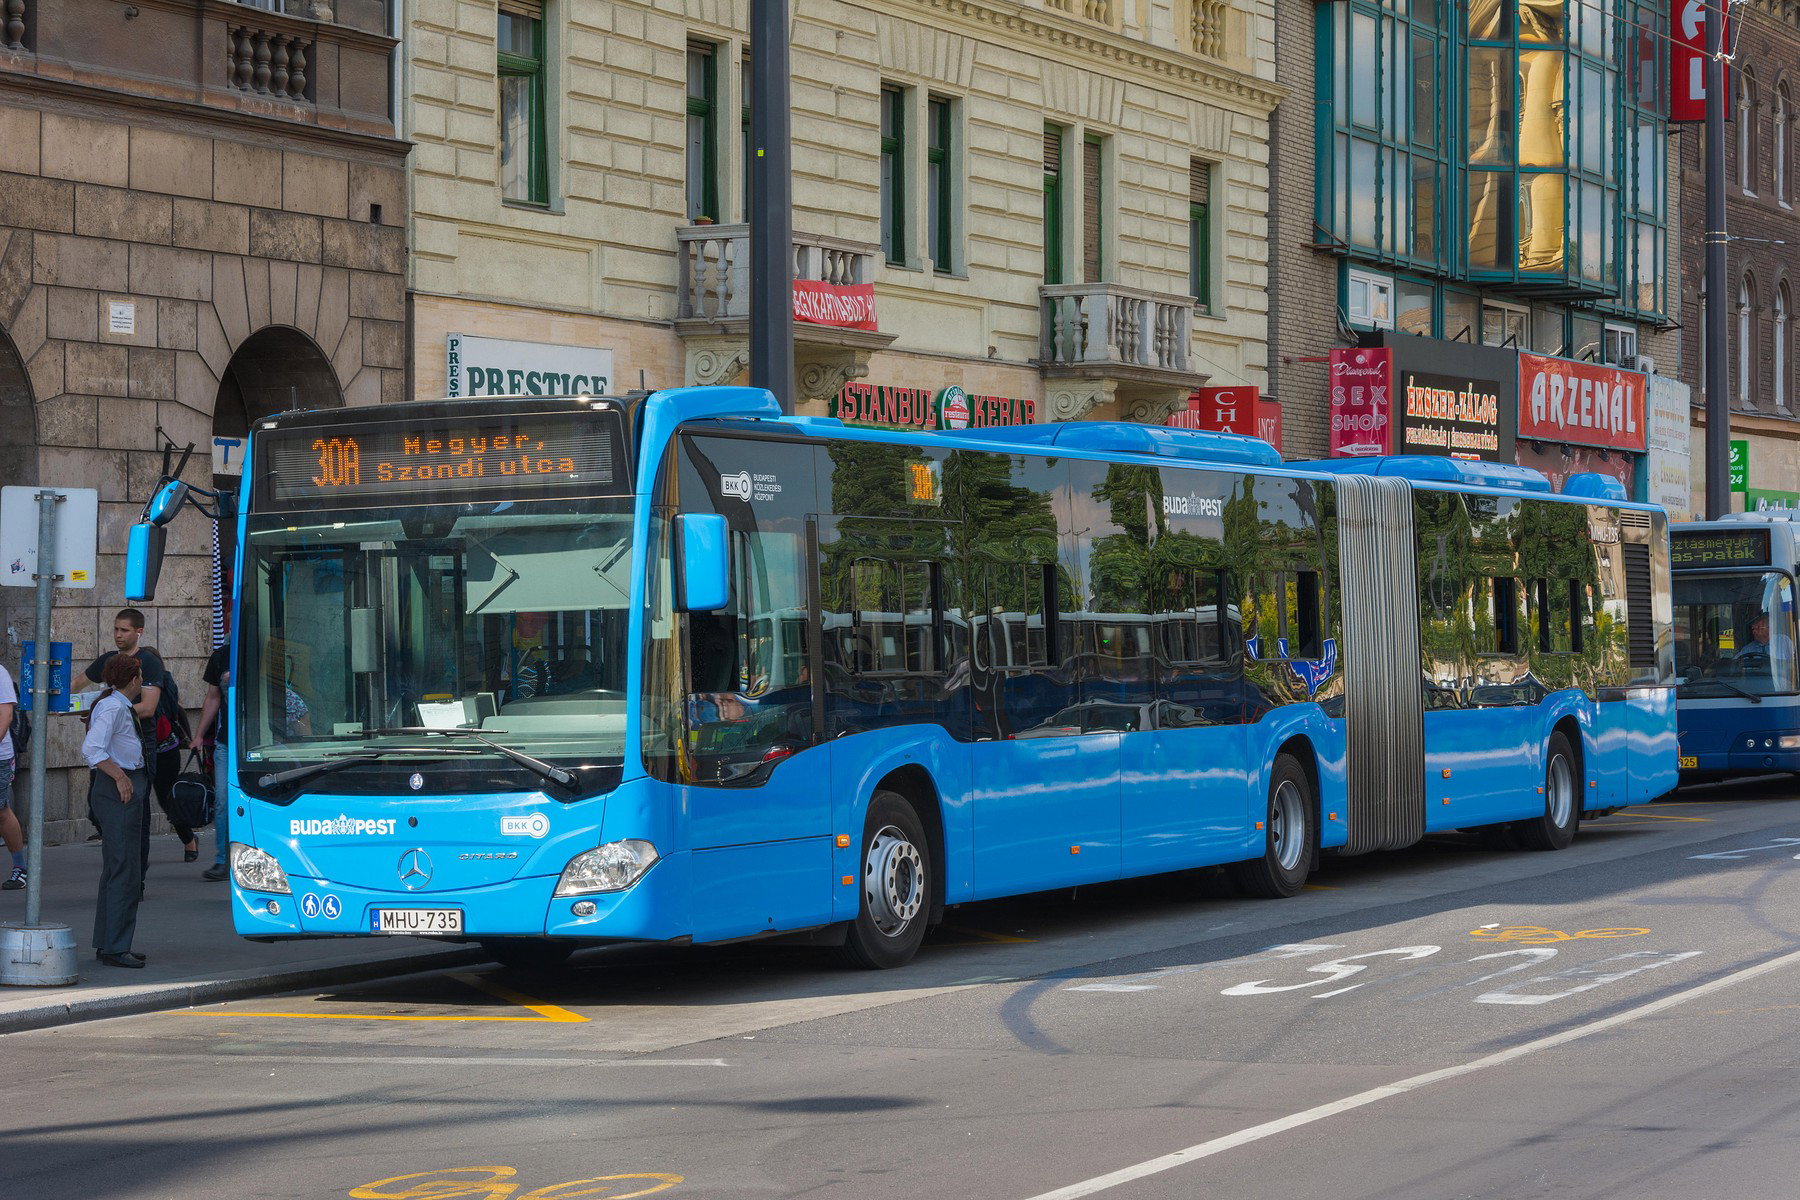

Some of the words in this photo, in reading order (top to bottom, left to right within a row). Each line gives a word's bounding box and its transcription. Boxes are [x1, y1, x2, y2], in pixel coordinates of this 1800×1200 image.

[466, 367, 608, 397] PRESTIGE
[836, 381, 937, 427] ISTANBUL
[1332, 386, 1387, 406] SEX
[1531, 371, 1636, 436] ARZENÁL
[973, 394, 1036, 429] KEBAB
[1332, 414, 1387, 431] SHOP
[404, 435, 544, 455] Megyer,
[312, 438, 359, 487] 30A
[377, 457, 484, 481] Szondi
[500, 454, 575, 475] utca
[725, 480, 739, 491] BKK
[1730, 474, 1744, 485] 24
[1591, 525, 1619, 543] MHU-735
[1671, 546, 1755, 563] as-patak
[507, 821, 528, 830] BKK
[458, 852, 518, 861] CITARO
[383, 911, 458, 929] MHU-735
